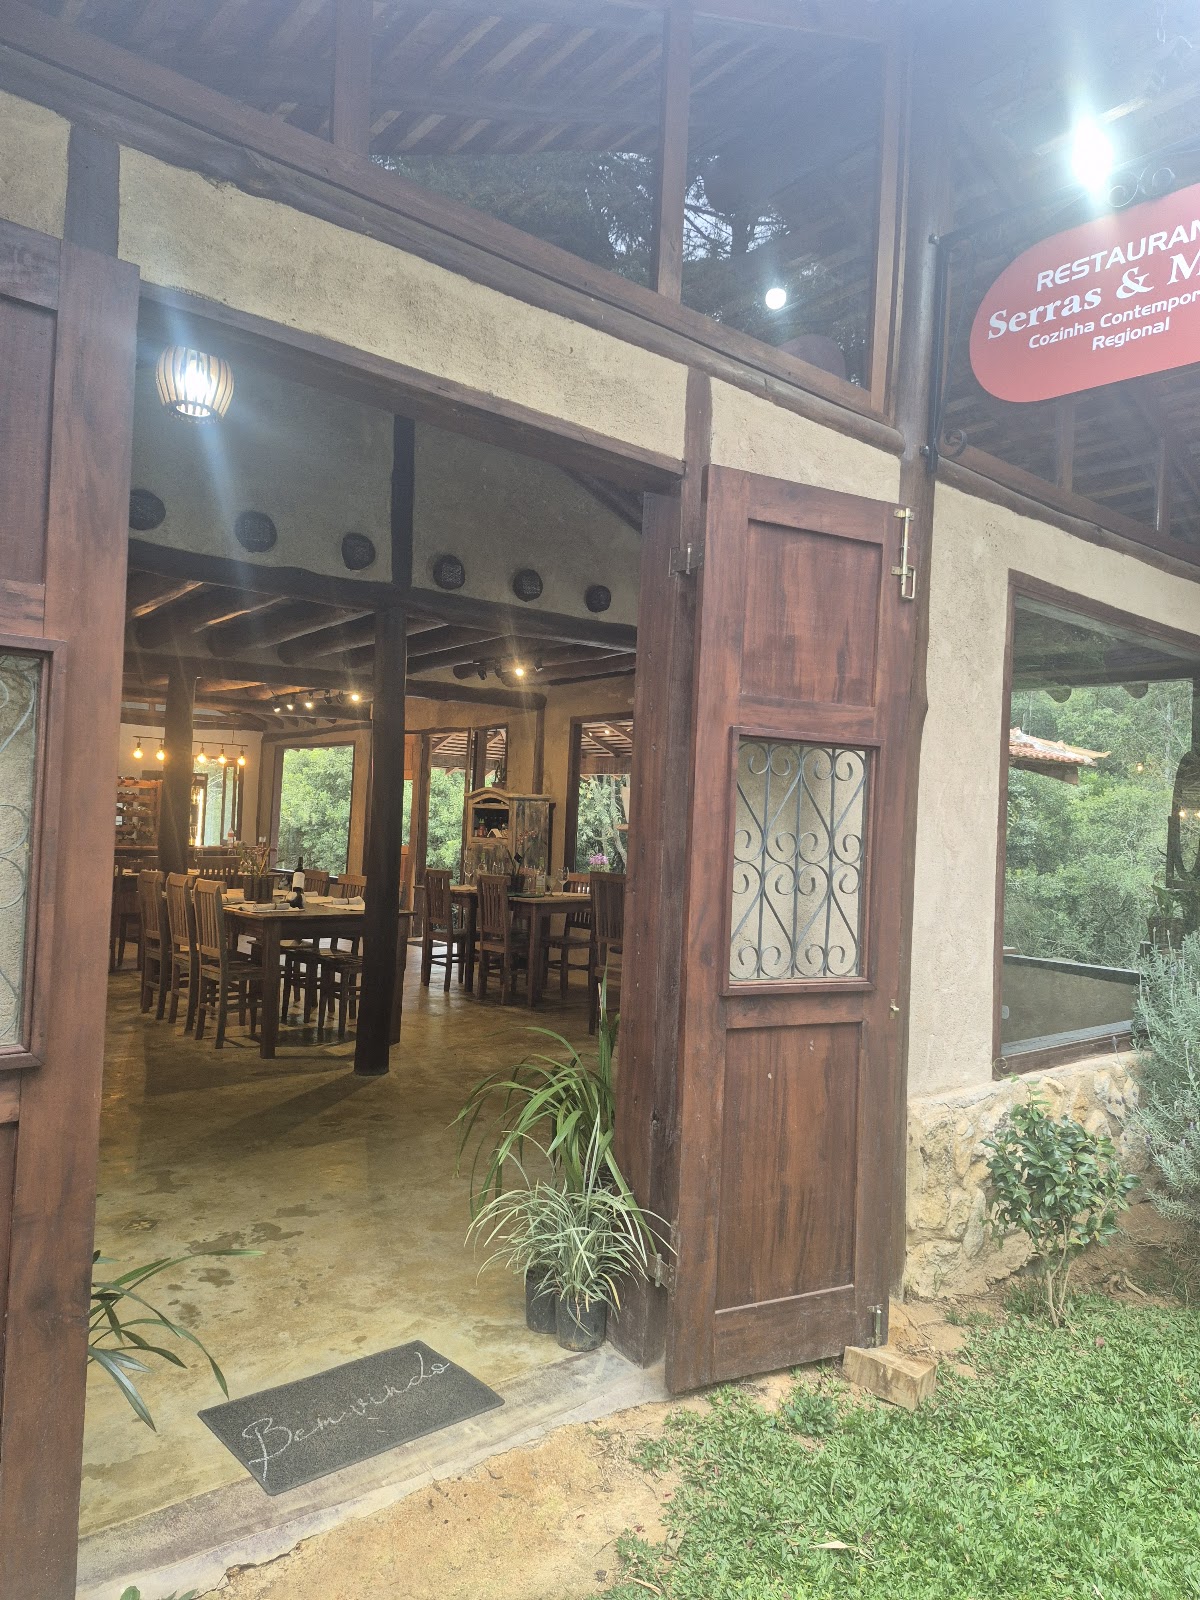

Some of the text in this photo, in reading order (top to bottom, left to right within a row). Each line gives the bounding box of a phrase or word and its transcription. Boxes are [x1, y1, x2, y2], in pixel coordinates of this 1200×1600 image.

[987, 287, 1102, 340] Serras
[1116, 266, 1155, 300] &
[1028, 320, 1095, 349] Cozinha
[1092, 316, 1170, 351] Regional
